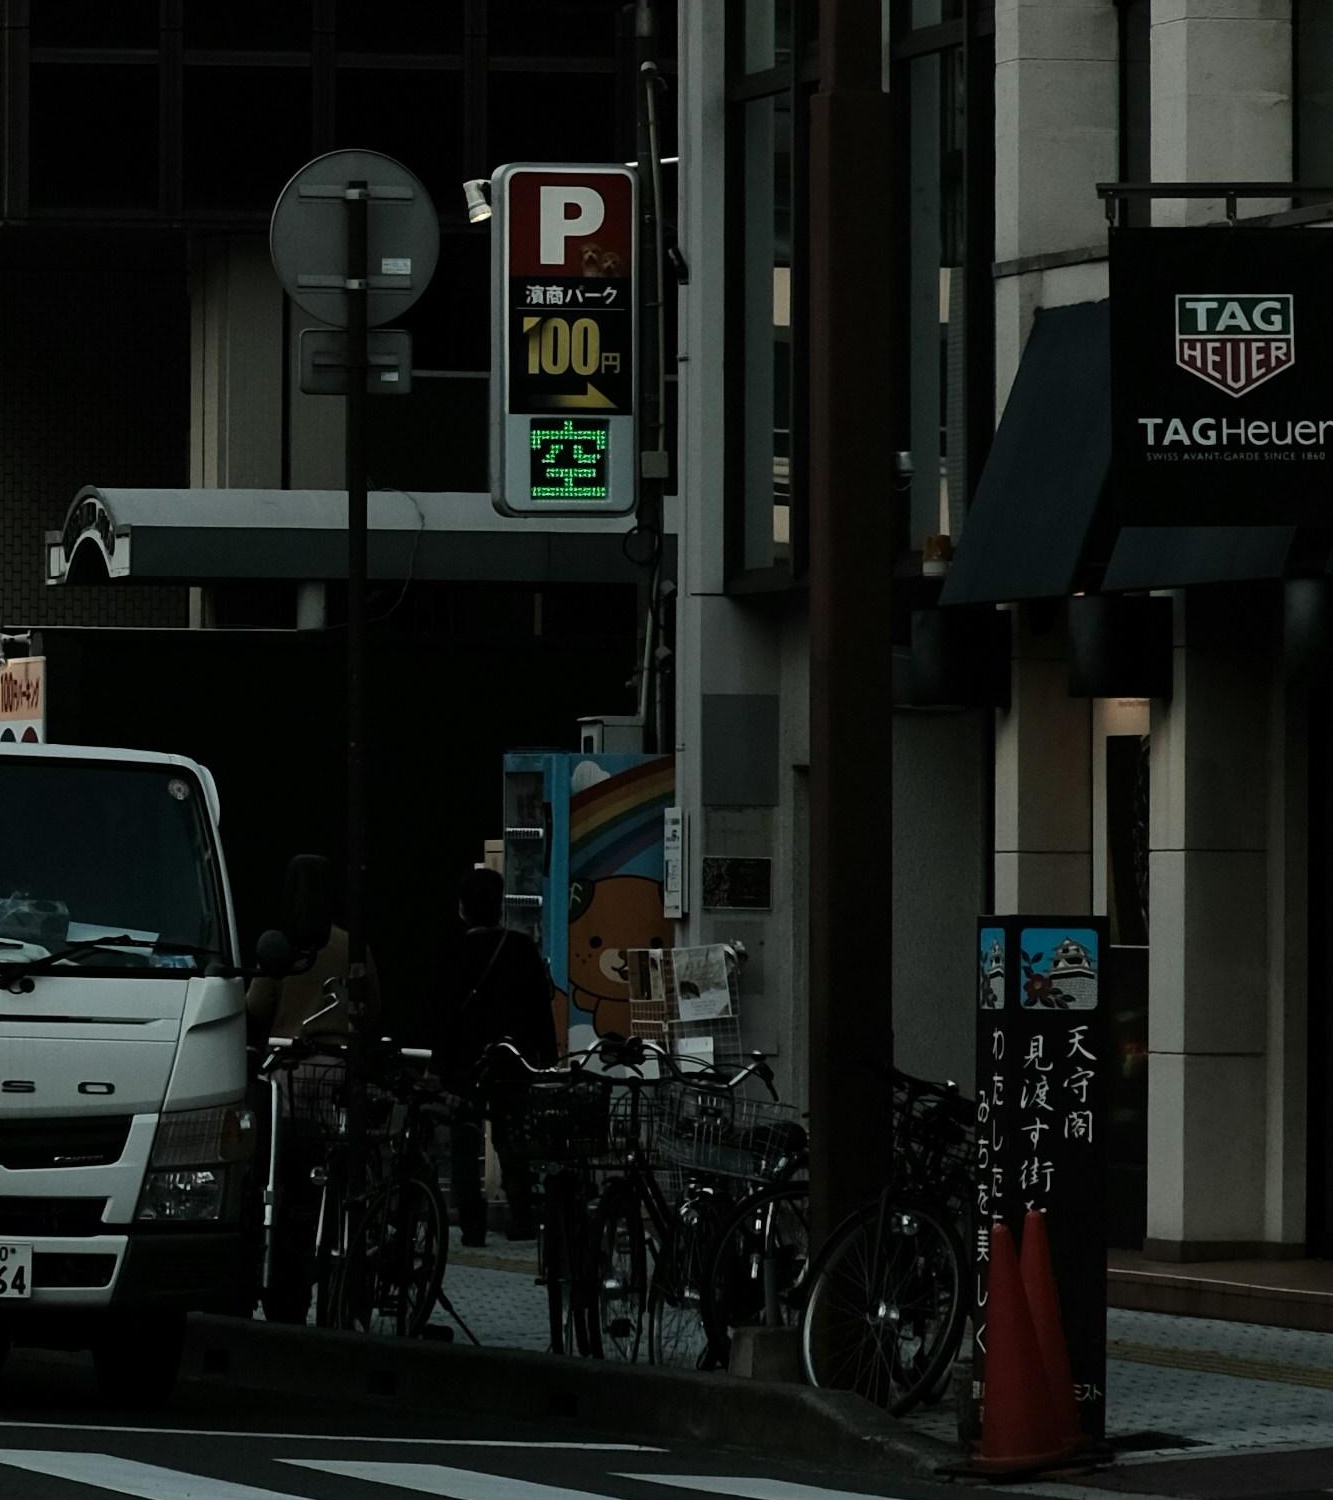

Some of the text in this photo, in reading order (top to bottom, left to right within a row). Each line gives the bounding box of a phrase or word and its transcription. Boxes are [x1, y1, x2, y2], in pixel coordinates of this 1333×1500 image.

[540, 186, 605, 264] P
[1185, 300, 1284, 332] TAG
[1183, 340, 1289, 389] HEUER
[531, 420, 606, 497] 空
[1146, 451, 1326, 462] SWISS AVANT-GARDE SINCE 1860
[1062, 1025, 1097, 1145] 天守閣
